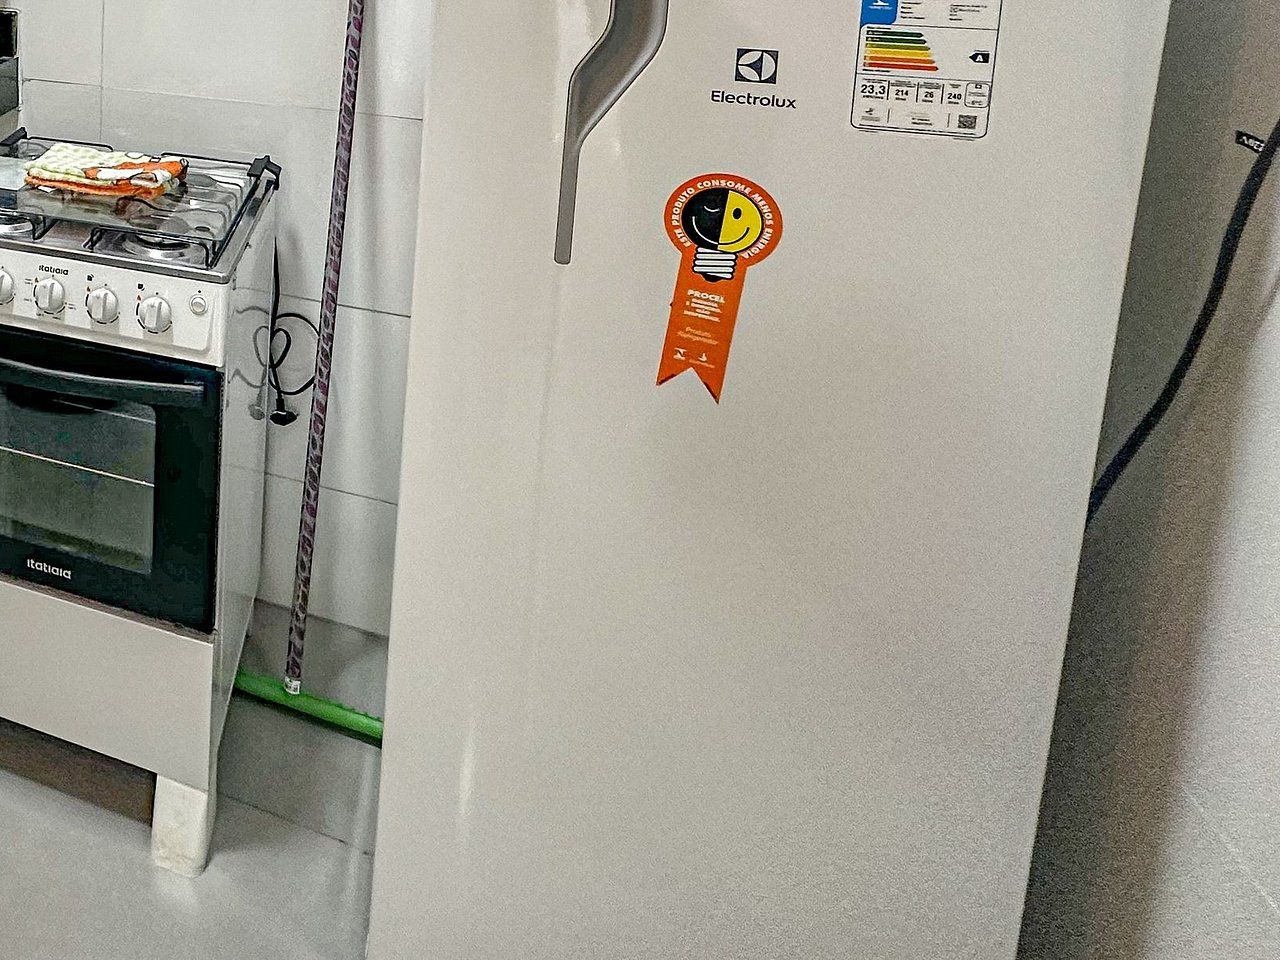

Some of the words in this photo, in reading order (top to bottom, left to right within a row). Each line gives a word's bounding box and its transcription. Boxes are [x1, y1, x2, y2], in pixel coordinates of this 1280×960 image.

[711, 90, 797, 109] Electrolux
[895, 89, 909, 97] 214
[947, 92, 962, 100] 240
[696, 179, 752, 195] CONSOME
[671, 187, 696, 226] PRODUTO
[751, 192, 774, 226] MENOS
[740, 227, 774, 259] ENERGIA
[687, 289, 726, 303] PROCEL
